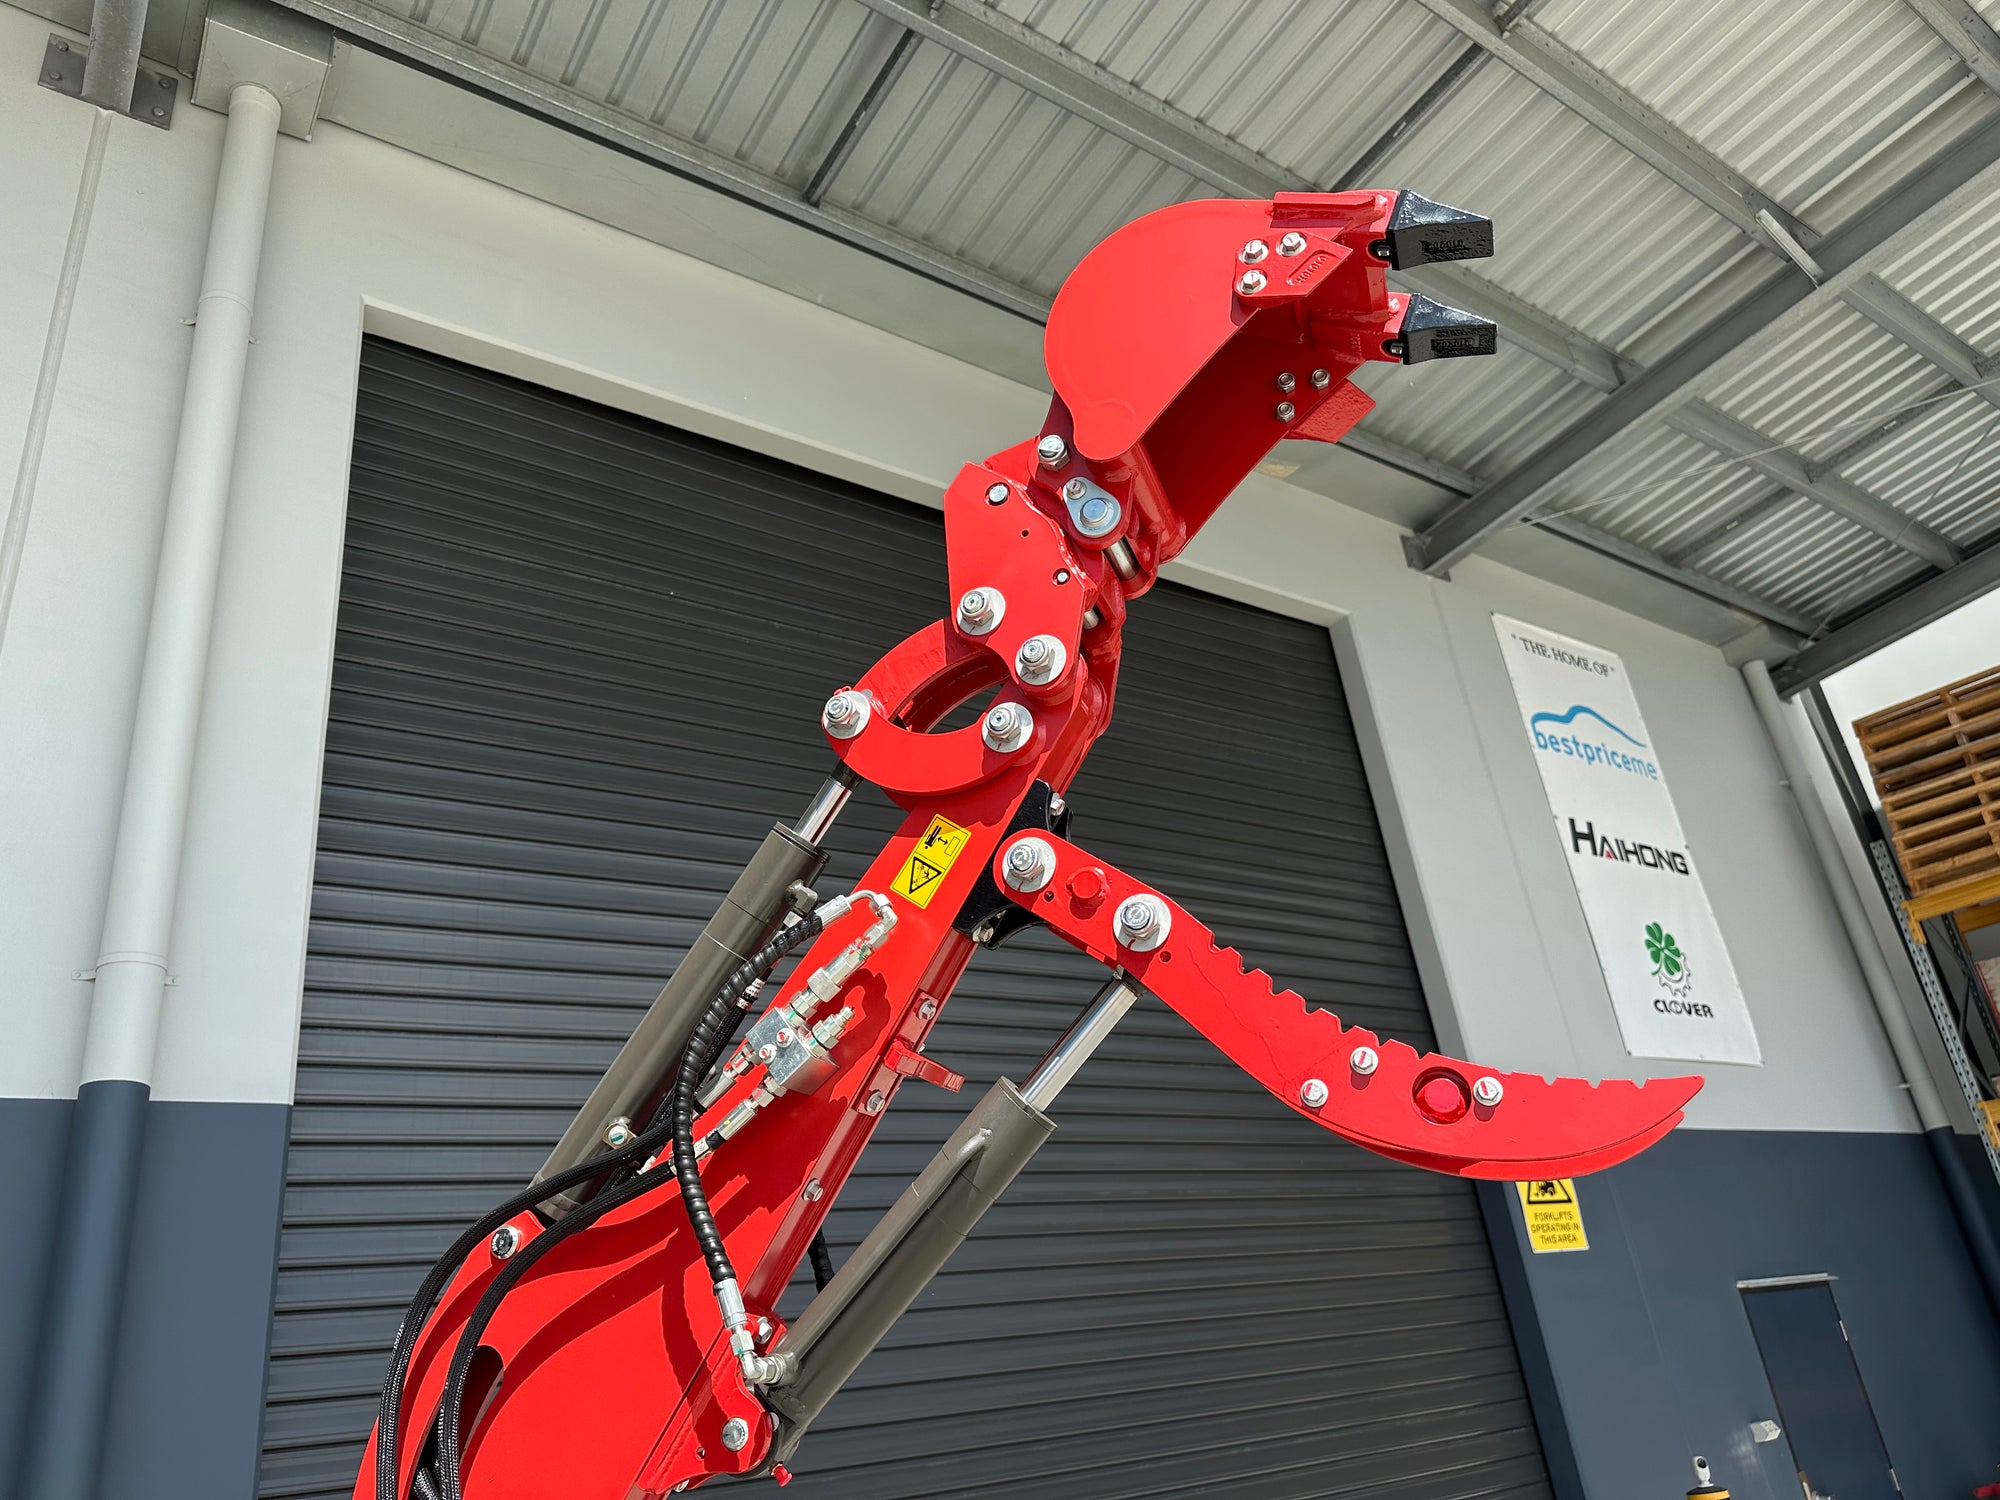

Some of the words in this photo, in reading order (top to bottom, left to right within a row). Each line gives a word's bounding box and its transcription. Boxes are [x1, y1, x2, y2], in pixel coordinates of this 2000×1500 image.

[1551, 648, 1592, 672] HOME
[1534, 729, 1659, 780] bestpriceme
[1568, 817, 1690, 876] HAIHONG
[1653, 998, 1714, 1018] CLOVER
[1534, 1211, 1573, 1221] FORKLIFTS
[1530, 1222, 1571, 1234] OPERATING
[1572, 1222, 1580, 1231] IN
[1540, 1234, 1557, 1244] THIS
[1558, 1233, 1578, 1243] AREA
